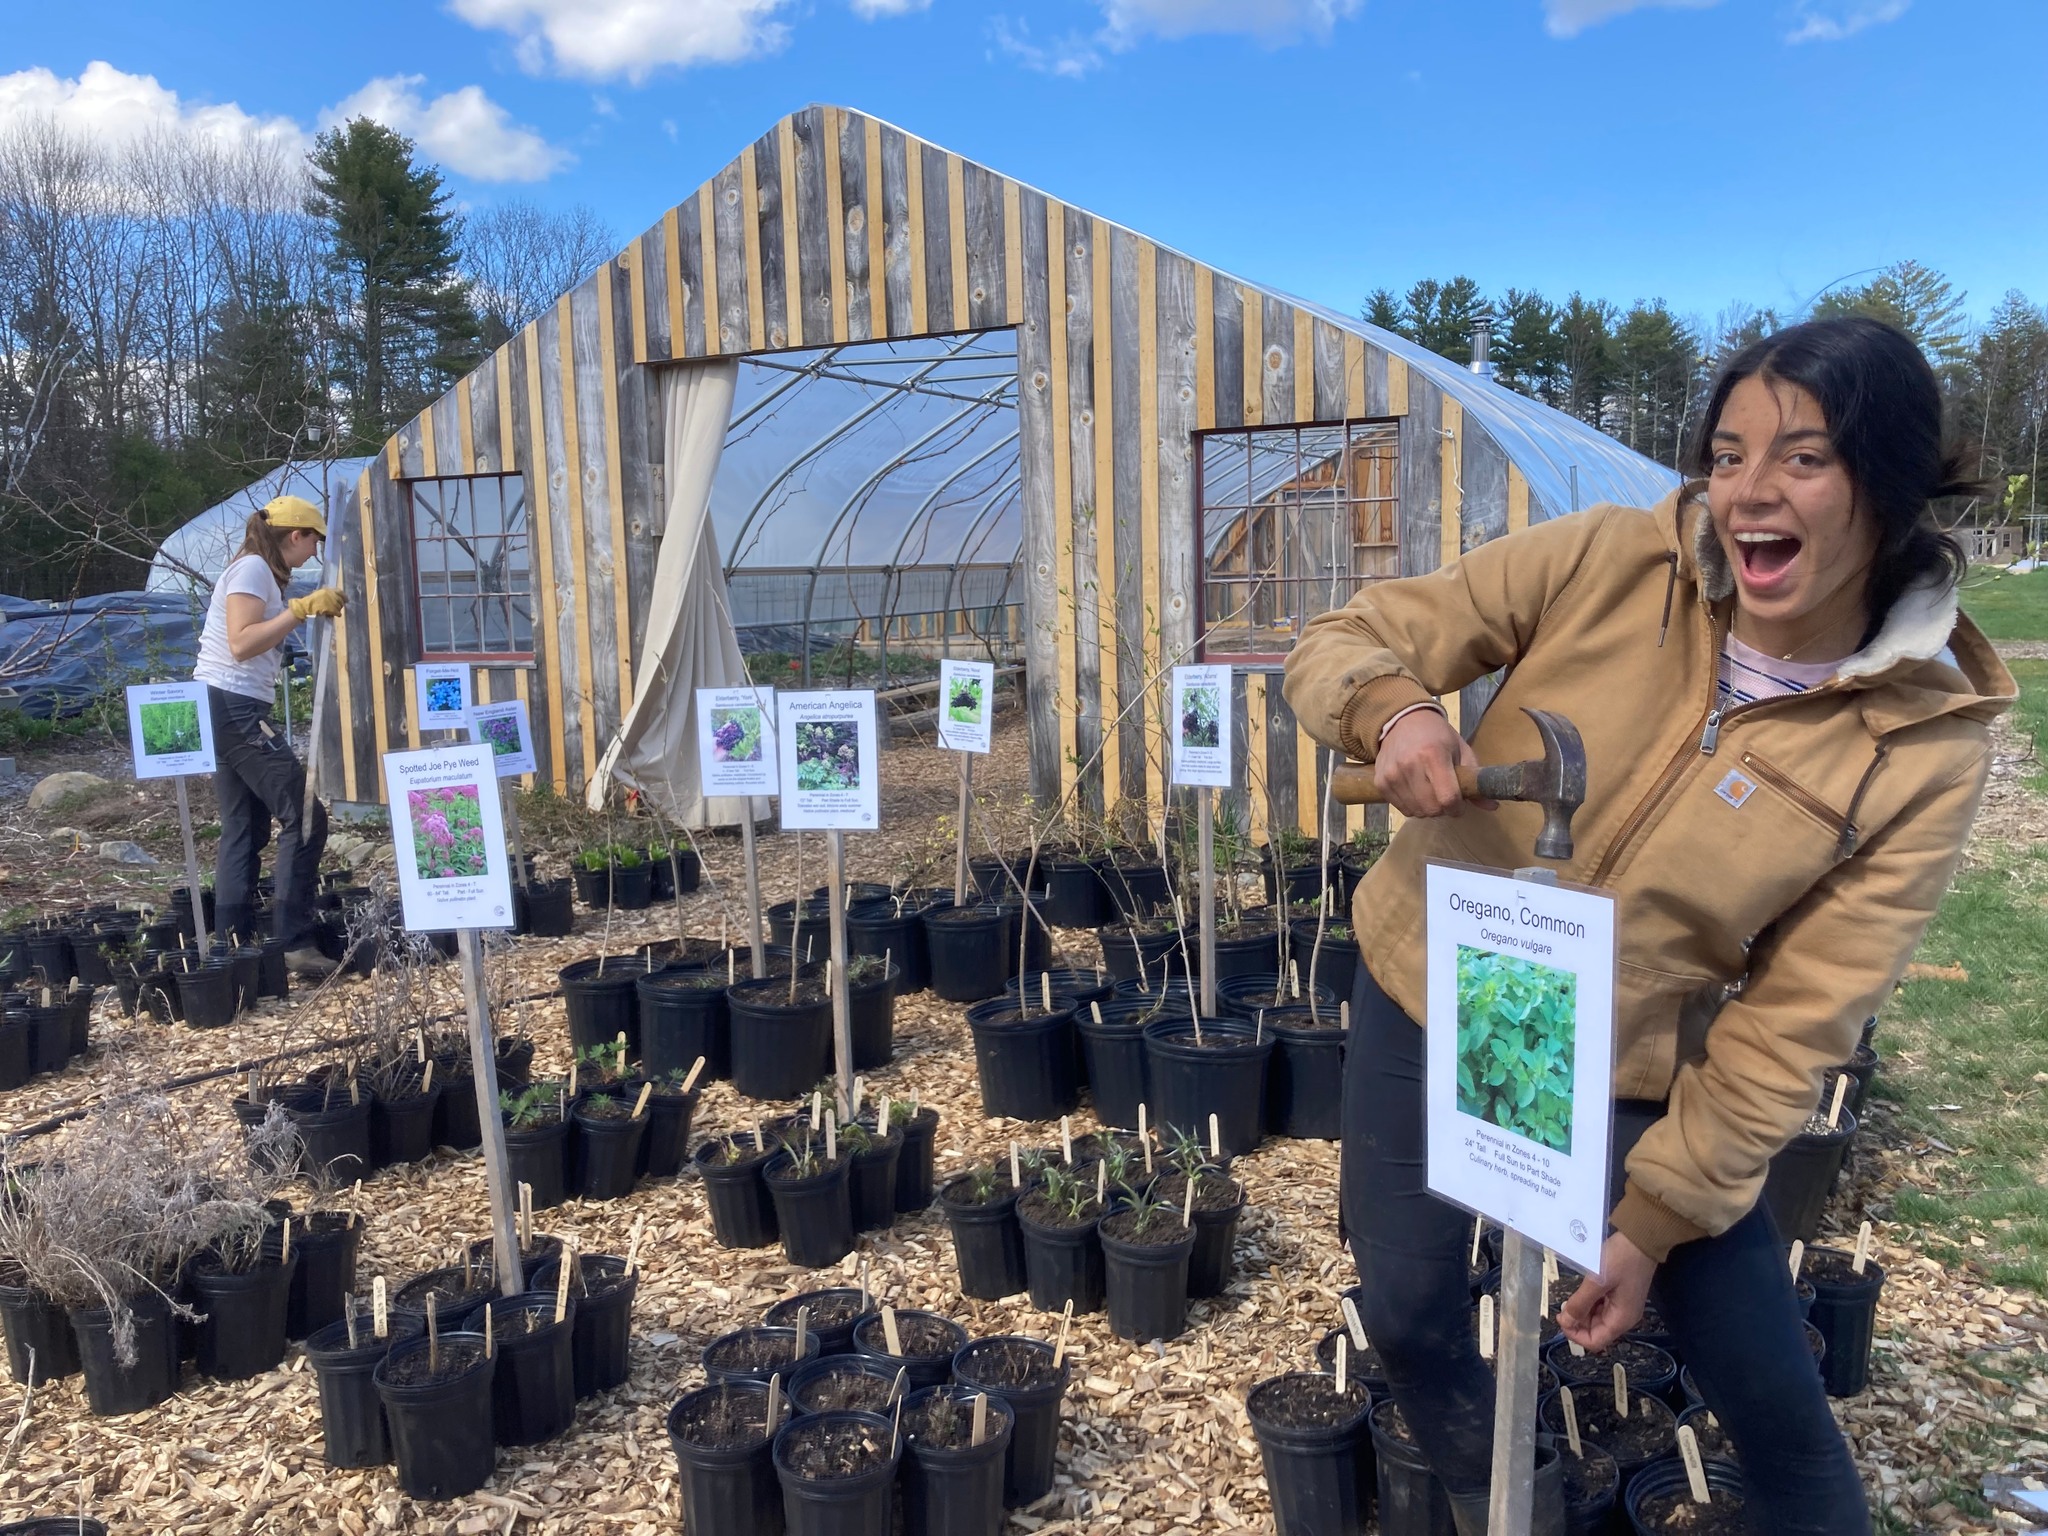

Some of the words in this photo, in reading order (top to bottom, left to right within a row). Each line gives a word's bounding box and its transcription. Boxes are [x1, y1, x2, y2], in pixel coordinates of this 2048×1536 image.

[485, 708, 504, 716] England
[789, 702, 827, 710] American
[829, 701, 863, 711] Angelica
[399, 763, 427, 775] Spotted
[429, 761, 442, 771] Joe
[444, 760, 457, 770] Pye
[458, 758, 479, 767] Weed
[410, 775, 441, 785] Eupatorium
[443, 772, 473, 782] maculatum
[1450, 893, 1515, 925] Oregano,
[1520, 907, 1585, 938] Common
[1480, 928, 1518, 947] Oregano
[1521, 939, 1552, 955] vulgare
[1476, 1129, 1504, 1148] Perennial
[1505, 1141, 1511, 1150] in
[1512, 1144, 1530, 1160] Zones
[1532, 1154, 1536, 1162] 4
[1542, 1158, 1550, 1168] 10
[1469, 1152, 1493, 1170] Culinary
[1494, 1163, 1508, 1178] herb,
[1511, 1172, 1539, 1192] spreading
[1541, 1185, 1556, 1199] habit
[1476, 1142, 1486, 1153] Tall
[1495, 1150, 1505, 1161] Full
[1507, 1156, 1518, 1167] Sun
[1520, 1162, 1525, 1171] to
[1527, 1164, 1539, 1178] Part
[1541, 1171, 1561, 1187] Shade
